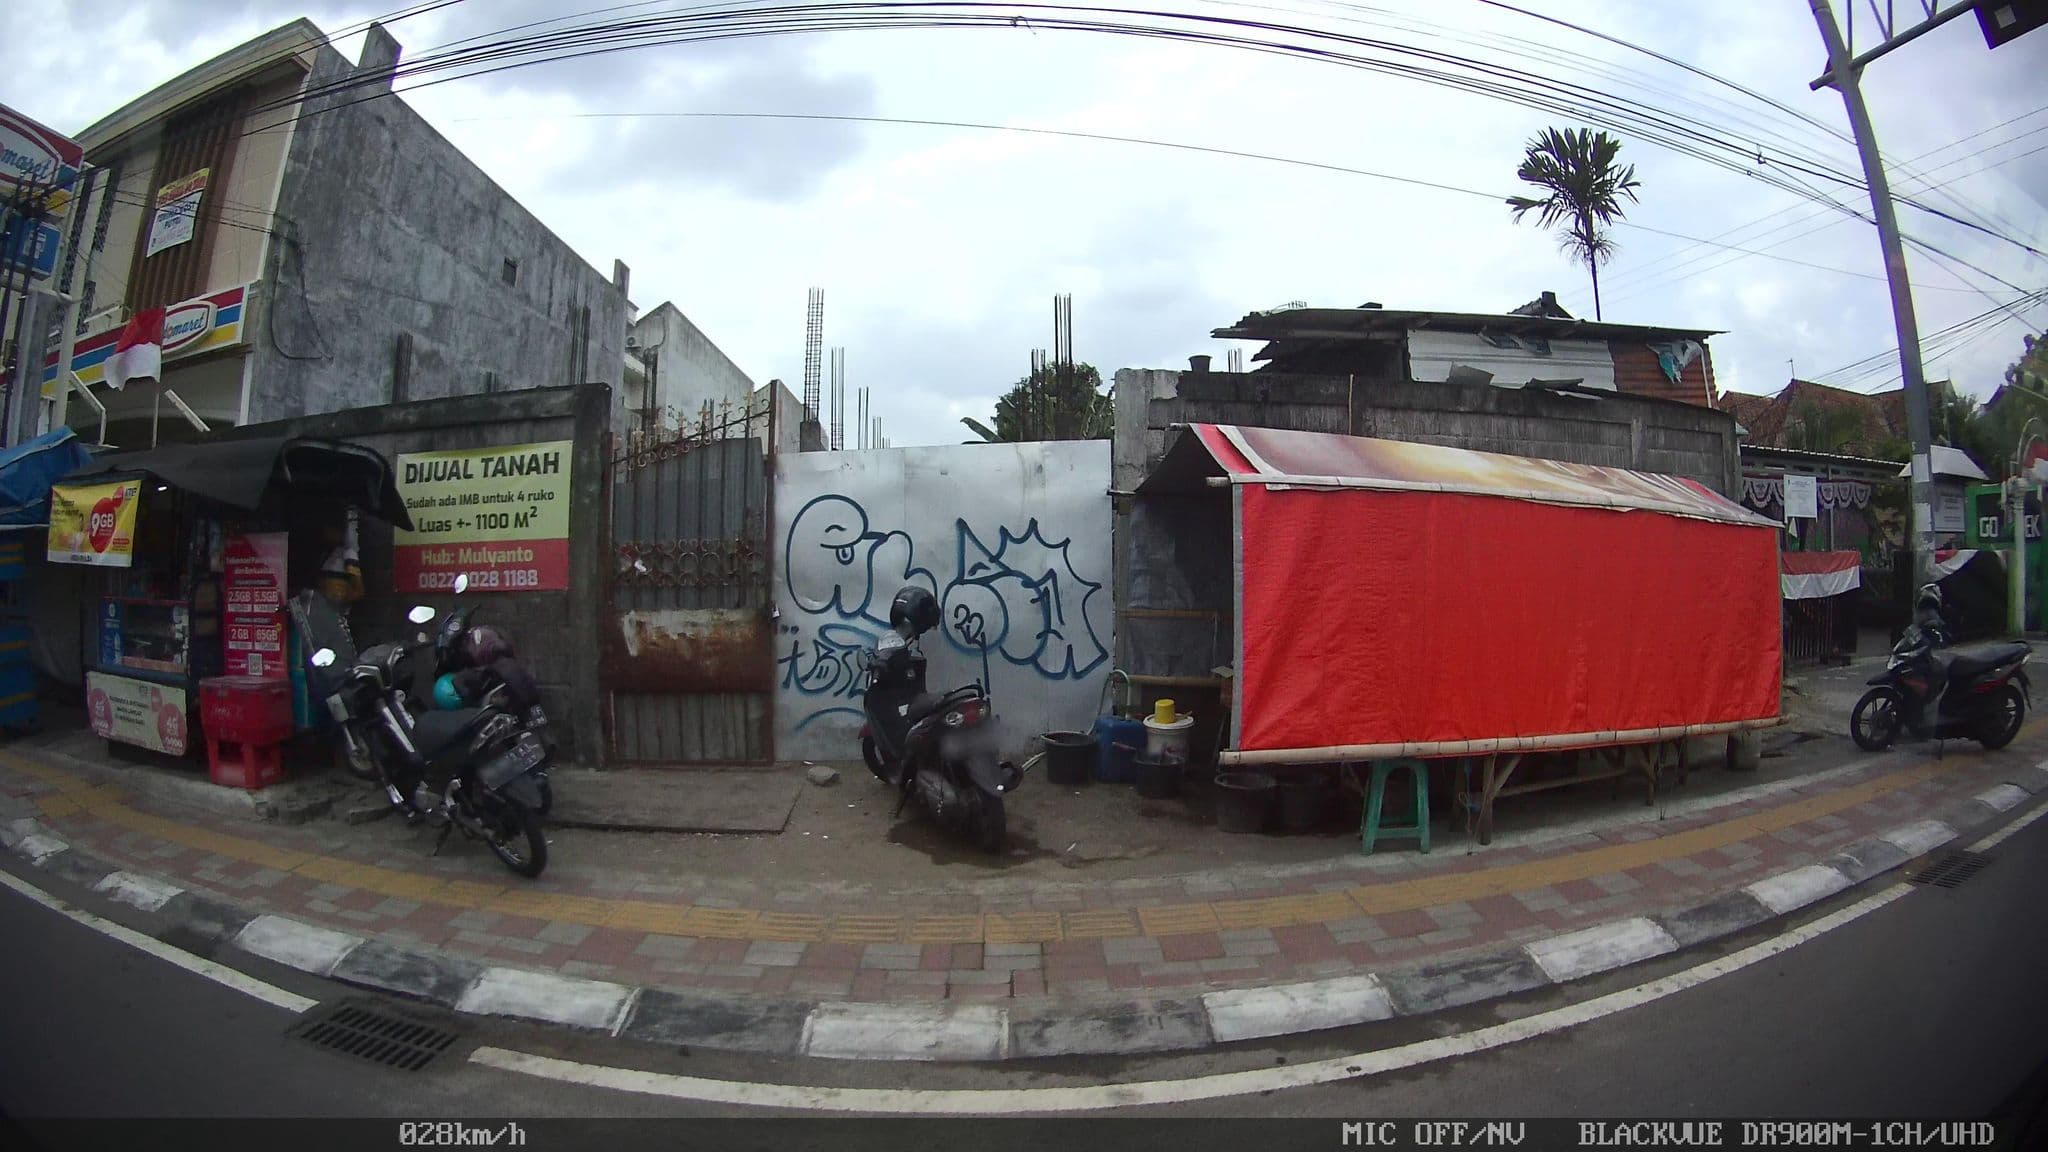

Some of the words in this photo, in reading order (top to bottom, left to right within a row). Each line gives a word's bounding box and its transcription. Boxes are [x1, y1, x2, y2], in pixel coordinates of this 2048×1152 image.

[405, 458, 474, 484] DIJUAL
[481, 452, 560, 478] TANAH
[406, 495, 436, 509] Sudah
[438, 493, 457, 506] ada
[459, 493, 480, 505] IMB
[482, 491, 514, 504] untuk
[517, 490, 525, 502] 4
[527, 489, 555, 501] ruko
[419, 517, 452, 533] Luas
[456, 518, 472, 529] +-
[475, 512, 509, 529] 1100
[1980, 516, 1999, 538] GO
[421, 551, 455, 565] Hub:
[458, 546, 534, 567] Mulyanto
[503, 569, 539, 587] 1188
